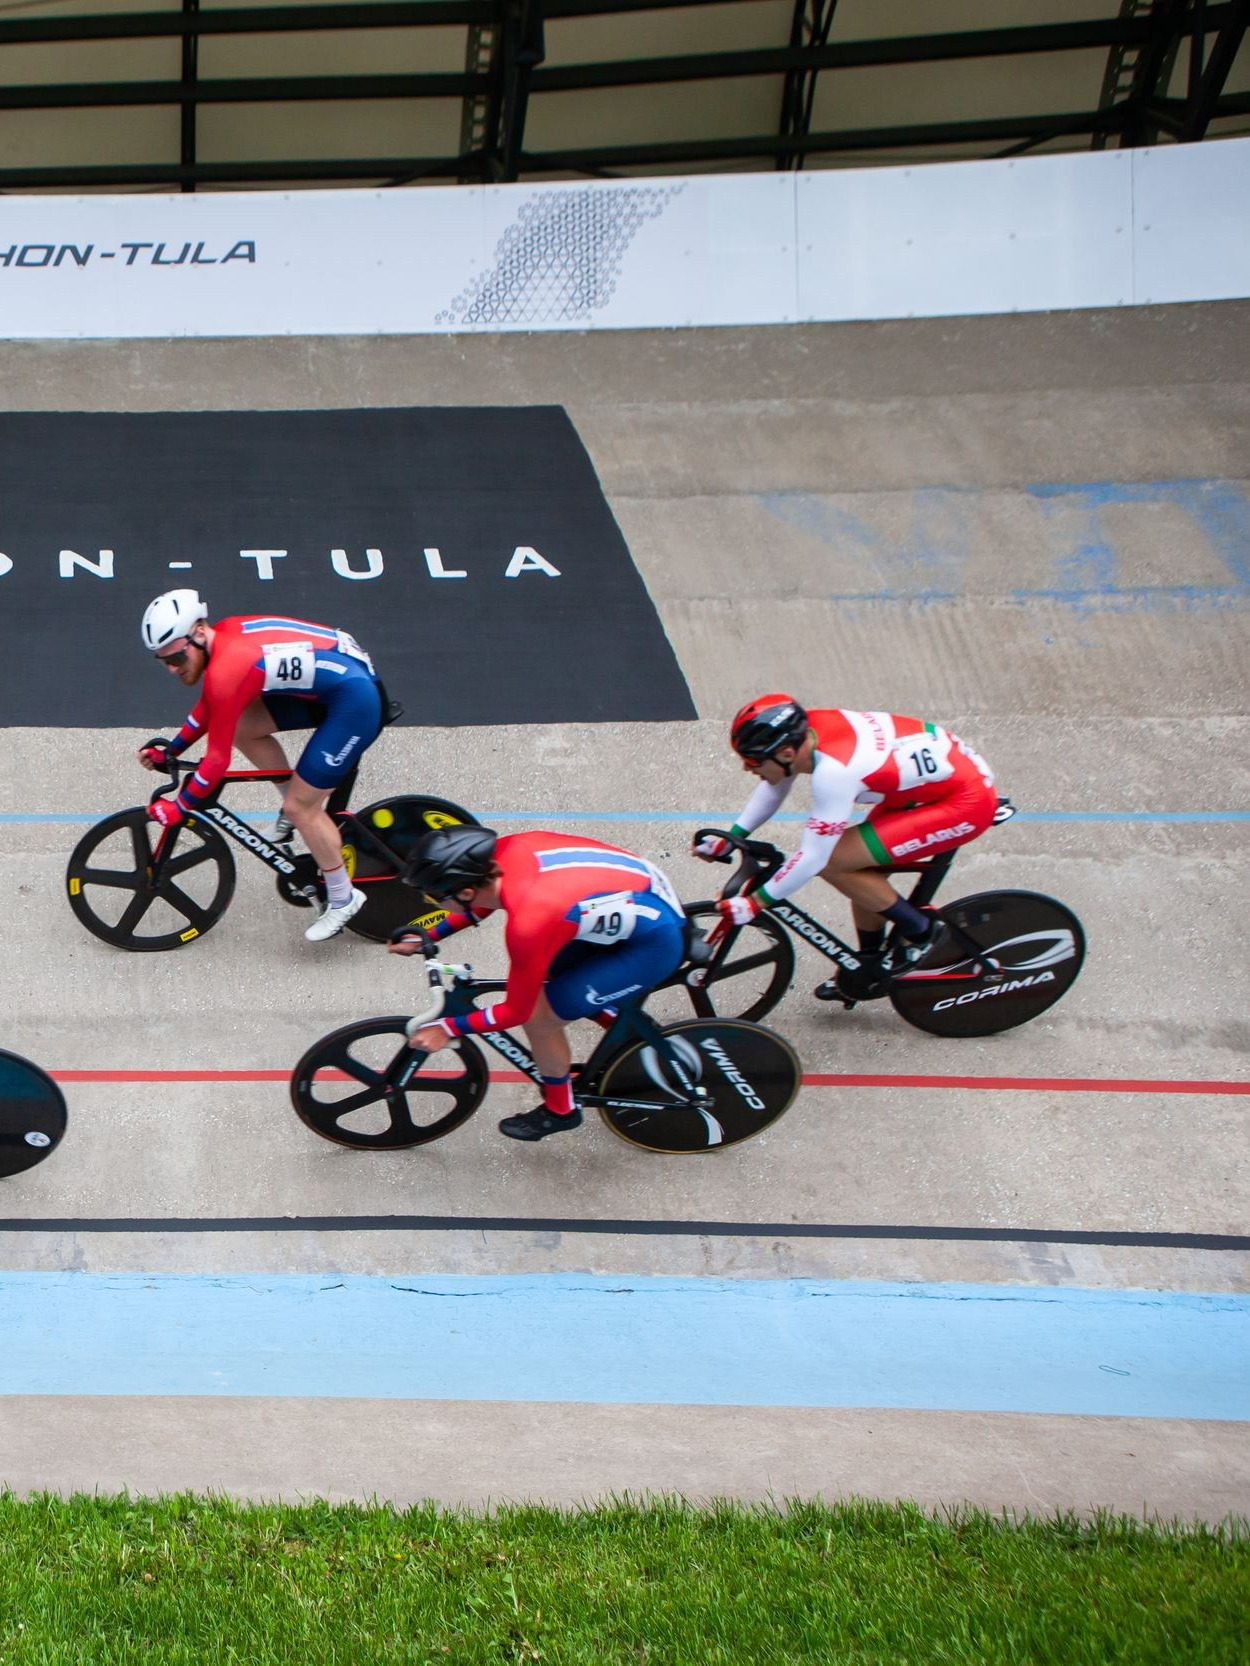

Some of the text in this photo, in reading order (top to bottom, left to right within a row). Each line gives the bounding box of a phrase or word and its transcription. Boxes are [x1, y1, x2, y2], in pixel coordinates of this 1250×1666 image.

[276, 656, 303, 681] 48
[910, 748, 938, 777] 16
[205, 808, 276, 859] ARGON
[272, 855, 296, 874] 18
[891, 821, 976, 857] BELARUS
[590, 911, 622, 937] 49
[771, 906, 841, 955] ARGON
[836, 953, 862, 971] 18
[932, 970, 1056, 1012] CORIMA
[481, 1031, 537, 1070] RGON
[700, 1037, 767, 1110] CORIMA
